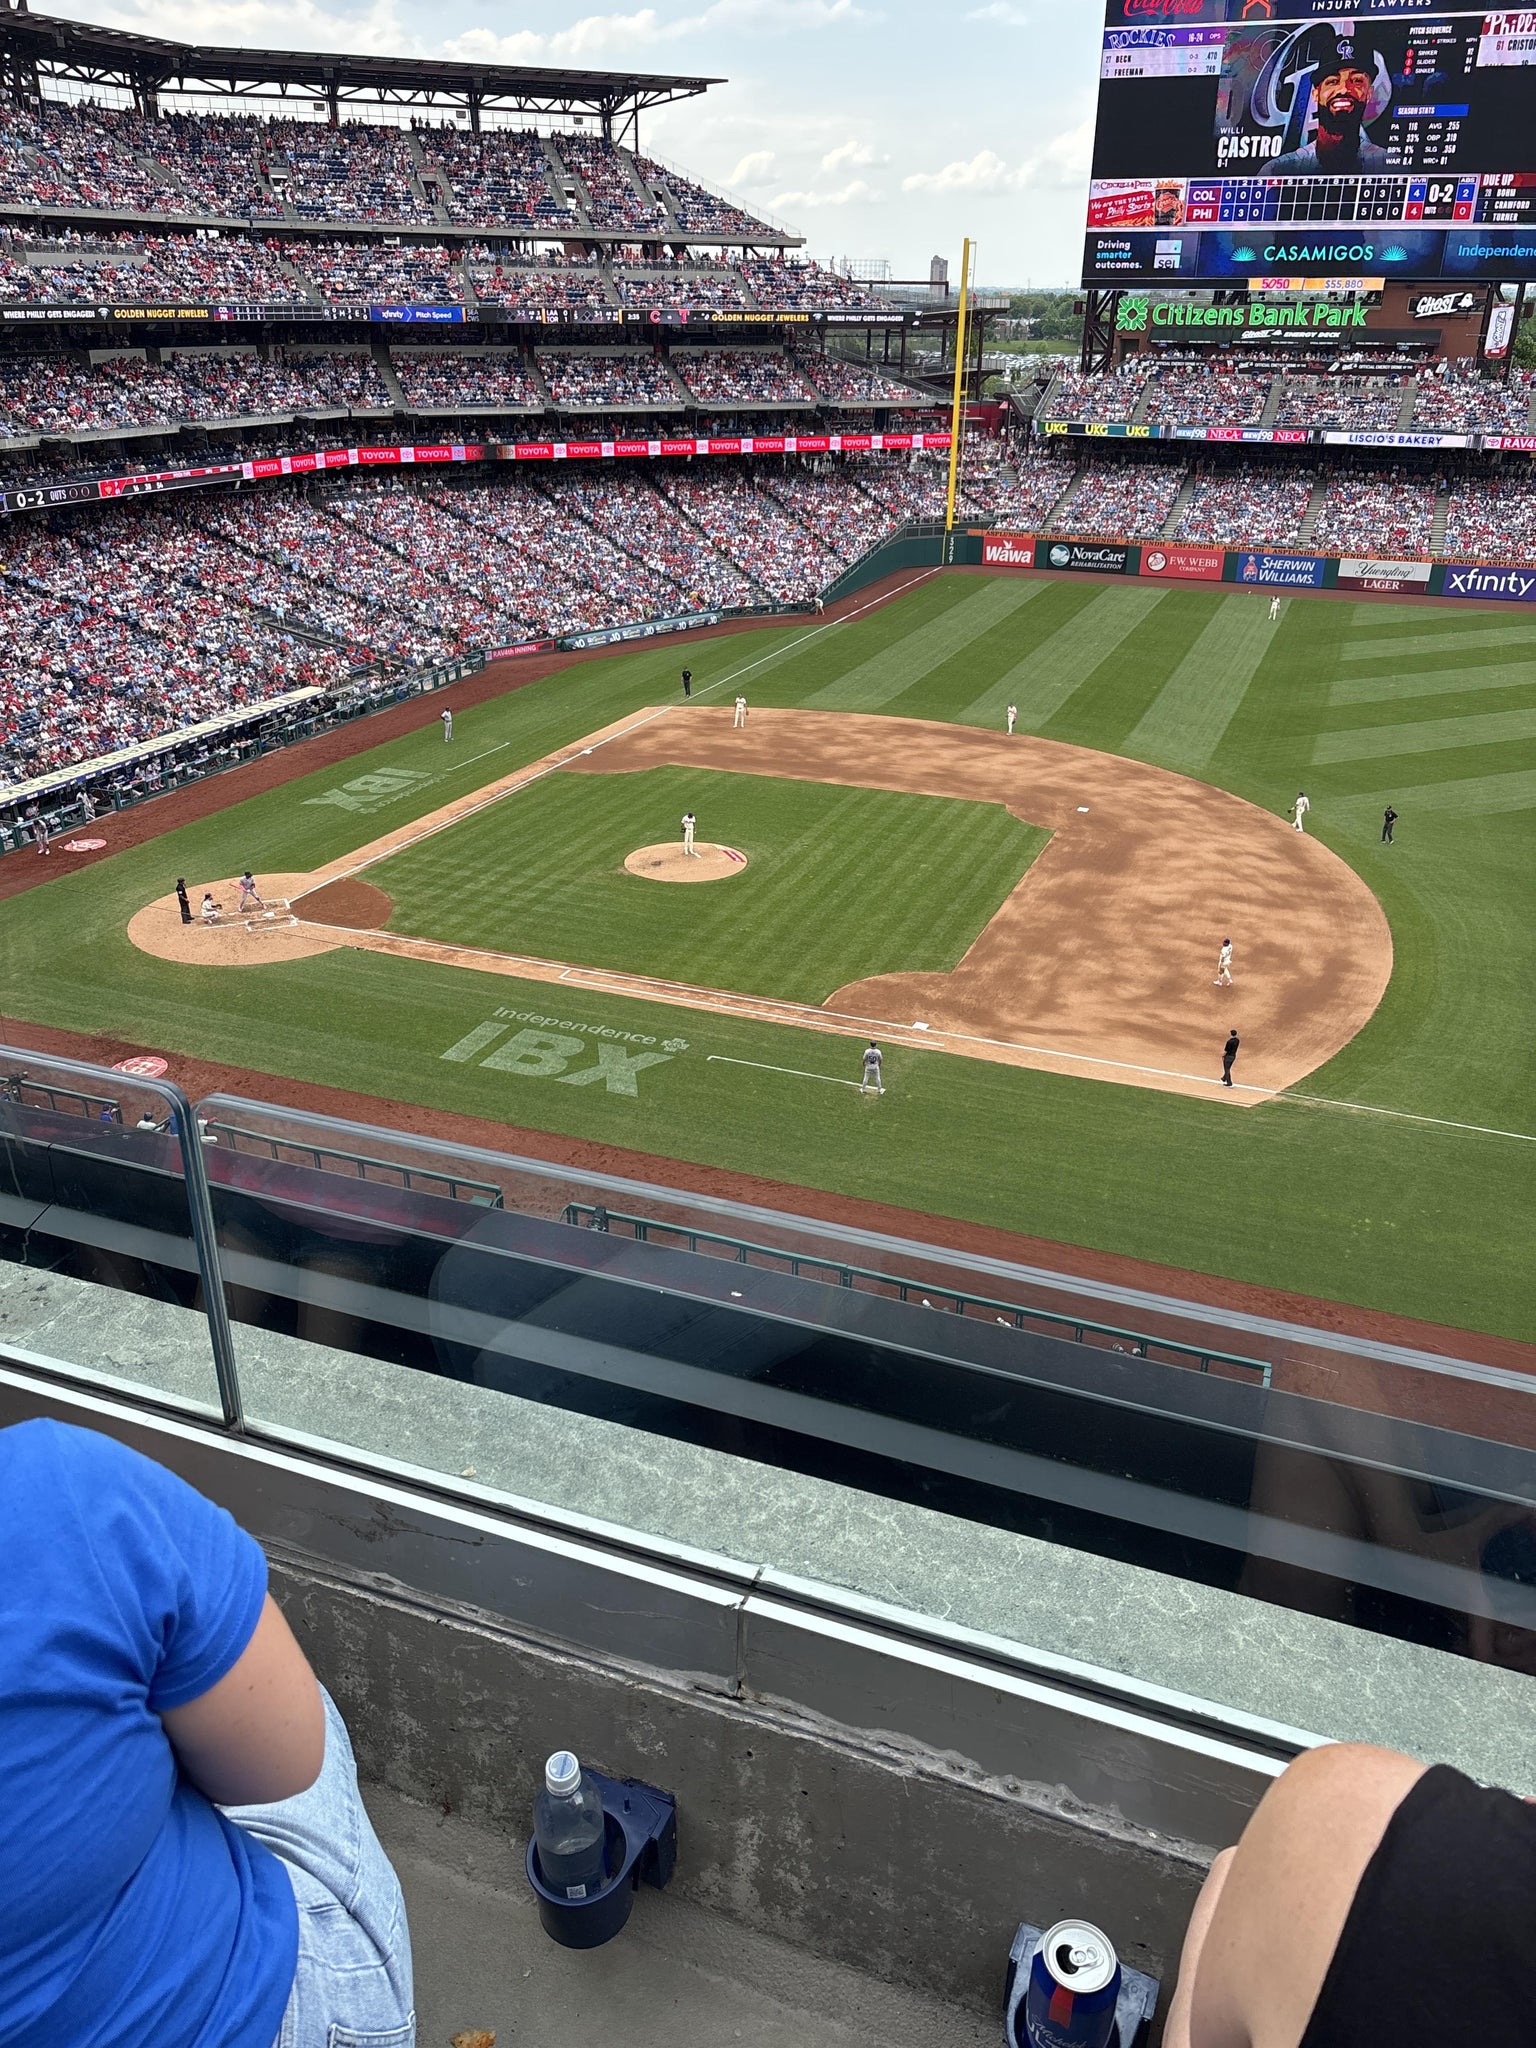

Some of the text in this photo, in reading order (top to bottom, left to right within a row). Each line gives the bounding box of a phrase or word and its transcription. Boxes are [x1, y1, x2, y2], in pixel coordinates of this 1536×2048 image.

[1313, 0, 1431, 11] INJURY LAWYERS
[1409, 25, 1452, 35] PITCH SEQUENCE
[1108, 29, 1175, 49] ROCKIES
[1496, 40, 1504, 50] 61
[1115, 55, 1132, 63] BECK
[1114, 68, 1144, 76] FREEMAN
[1398, 107, 1418, 115] SEASON
[1217, 135, 1282, 158] CASTRO
[1483, 174, 1514, 186] DUE UP
[1192, 189, 1401, 201] COL 0 0 0 0 3 1
[1413, 189, 1421, 198] 4
[1428, 184, 1454, 203] 0-2
[1462, 189, 1469, 198] 2
[1496, 188, 1516, 197] BOHM
[1128, 195, 1148, 203] TASTE
[1126, 201, 1151, 212] Sports
[1494, 200, 1530, 209] CRAWFORD
[1192, 207, 1399, 219] PHI 2 3 0 5 6 0
[1410, 207, 1417, 216] 4
[1424, 206, 1437, 214] OUTS
[1459, 207, 1466, 216] 0
[1492, 213, 1518, 222] TURNER
[1097, 240, 1131, 251] Driving
[1096, 251, 1132, 259] smarter
[1263, 245, 1374, 261] CASAMIGOS
[1095, 260, 1142, 269] outcomes.
[1324, 278, 1363, 289] $55,880
[1415, 292, 1465, 318] GHOST
[3, 310, 26, 319] WHERE
[26, 310, 46, 319] PHILLY
[47, 310, 62, 319] GETS
[114, 309, 209, 318] GOLDEN NUGGET JEWELERS
[382, 311, 403, 319] xfinity
[432, 311, 452, 319] Speed
[711, 314, 809, 322] GOLDEN NUGGET JEWELERS
[1152, 302, 1369, 327] Citizens Bank Park
[1044, 422, 1068, 434] UKG
[1085, 424, 1109, 436] UKG
[1126, 425, 1150, 437] UKG
[1210, 429, 1239, 439] NECA
[1276, 431, 1306, 441] NECA
[798, 439, 826, 448] TOYOTA
[843, 438, 870, 447] TOYOTA
[885, 437, 911, 446] TOYOTA
[925, 436, 950, 444] TOYOTA
[1349, 433, 1443, 445] LISCIO'S BAKERY
[616, 445, 646, 453] TOYOTA
[663, 443, 692, 451] TOYOTA
[711, 442, 740, 450] TOYOTA
[754, 440, 783, 449] TOYOTA
[416, 449, 450, 458] TOYOTA
[517, 447, 549, 456] TOYOTA
[568, 446, 600, 454] TOYOTA
[325, 454, 348, 464] TOYOTA
[361, 451, 396, 459] TOYOTA
[254, 462, 279, 473] TOYOTA
[291, 458, 315, 469] TOYOTA
[16, 489, 67, 507] 0-2 OUTS
[1078, 536, 1117, 544] ASPLUNDH
[1172, 542, 1214, 550] ASPLUNDH
[986, 545, 1032, 564] Wawa
[1071, 547, 1125, 563] NovaCare
[1377, 554, 1422, 562] ASPLUNDH
[1070, 560, 1122, 570] REHABILITATION
[1169, 556, 1218, 568] F.W. WEBB
[1261, 556, 1315, 571] SHERWIN
[1431, 557, 1478, 566] ASPLUNDH
[1487, 560, 1534, 568] ASPLUNDH
[1354, 561, 1415, 579] Yuengling
[1363, 579, 1400, 590] LAGER
[1449, 567, 1536, 596] xfinity
[492, 645, 536, 658] RAV4th INNING
[492, 1006, 658, 1045] Independence
[439, 1021, 676, 1098] IBX
